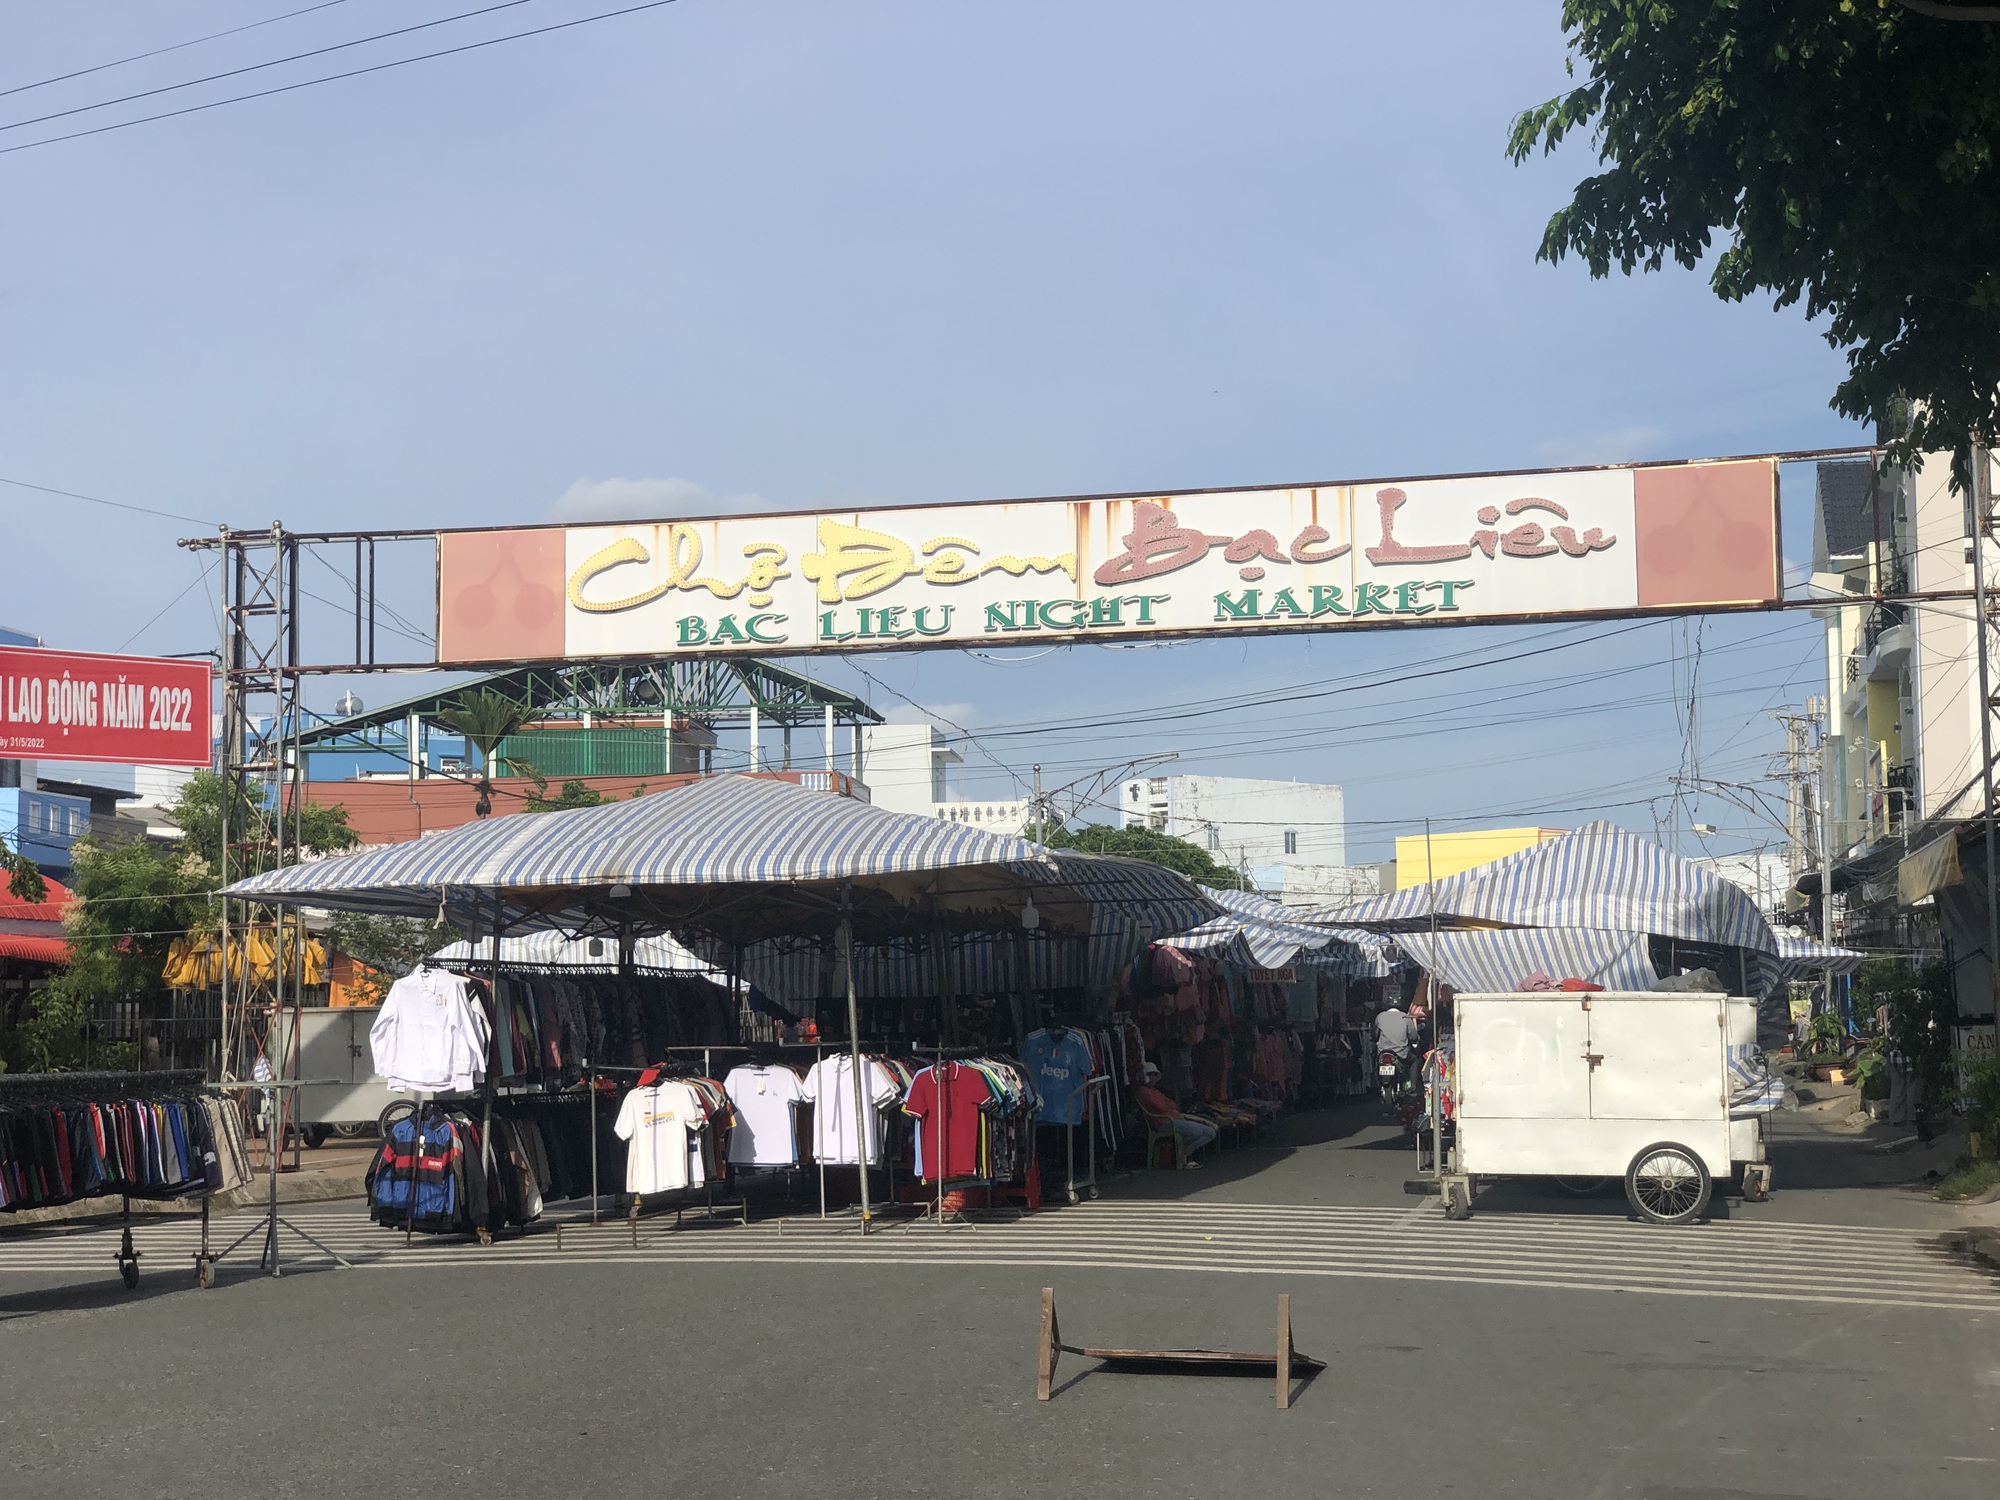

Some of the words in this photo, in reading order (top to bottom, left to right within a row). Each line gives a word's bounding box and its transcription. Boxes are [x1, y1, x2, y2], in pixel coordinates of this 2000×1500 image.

[567, 524, 791, 611] Chợ
[801, 518, 1077, 603] Đêm
[1094, 501, 1351, 585] Bạc
[1365, 488, 1617, 565] Liêu
[676, 613, 790, 646] BAC
[818, 604, 955, 642] LIEU
[984, 593, 1170, 634] NIGHT
[1213, 579, 1476, 621] MARKET
[8, 676, 43, 724] LAO
[47, 670, 98, 736] ĐỘNG
[103, 675, 145, 729] NĂM
[149, 685, 192, 732] 2022
[10, 736, 45, 748] 31/5/2022
[1278, 968, 1294, 981] NGA
[1041, 1063, 1070, 1080] Jeep
